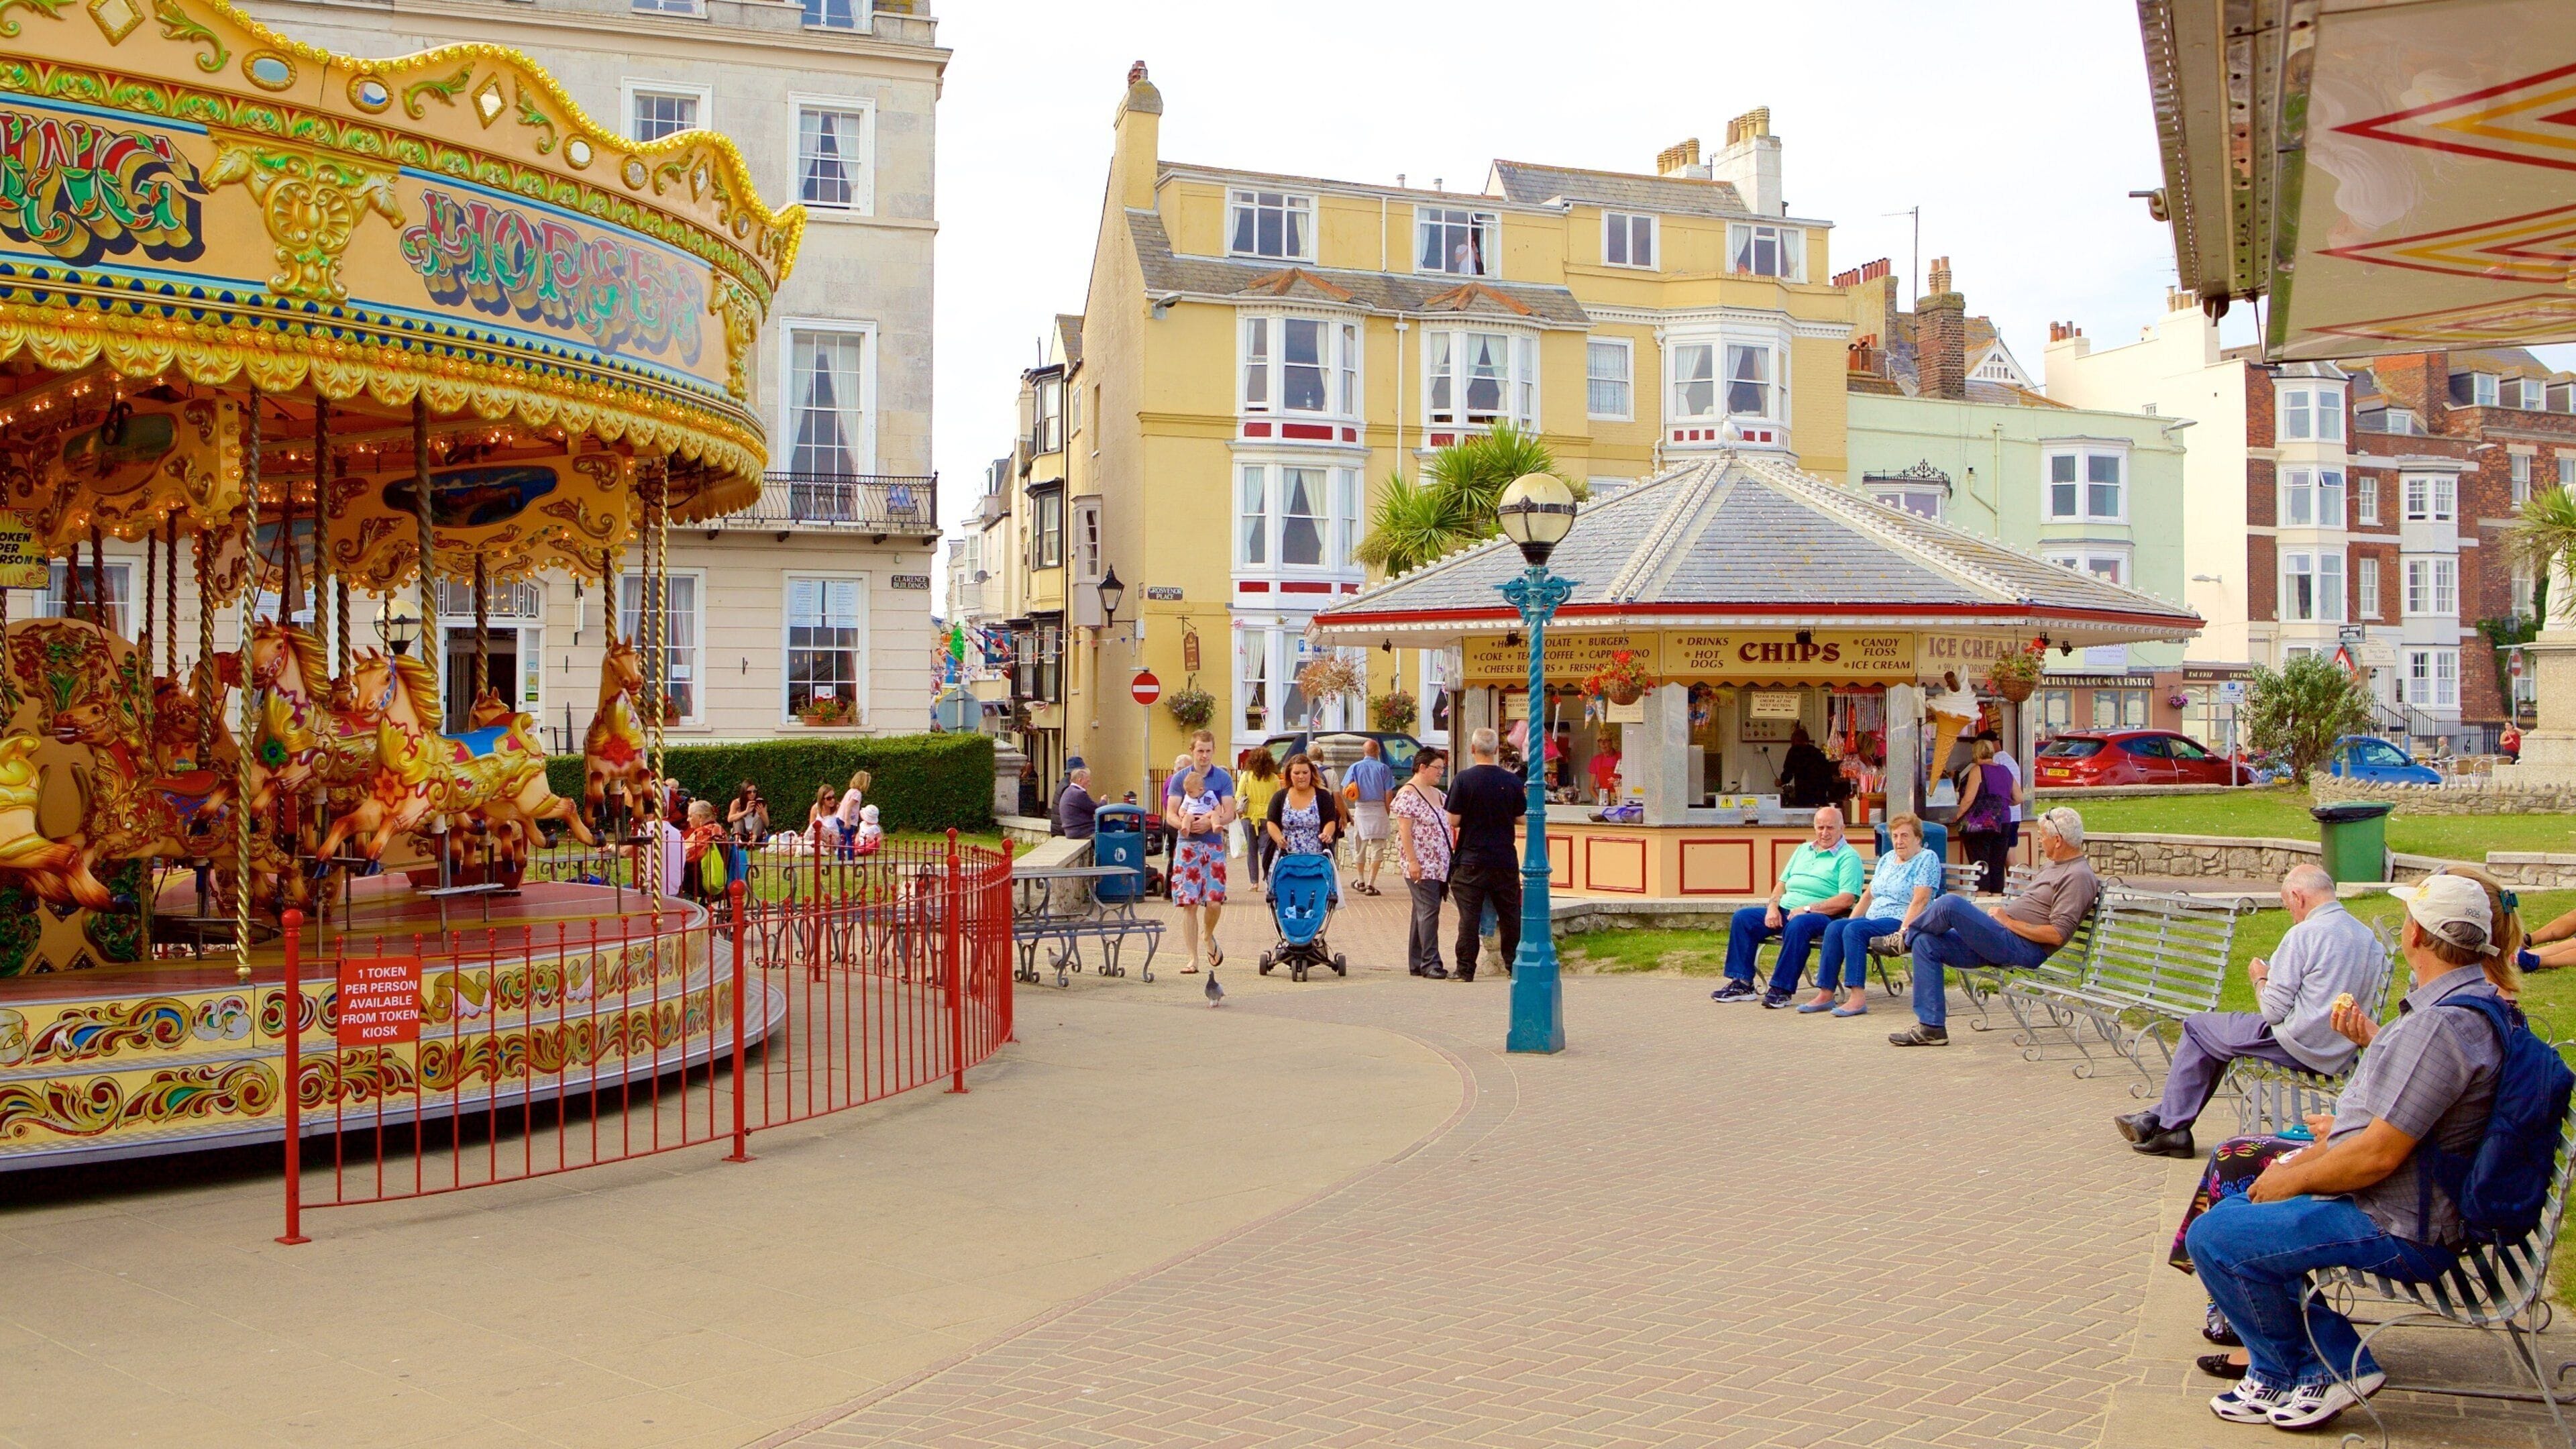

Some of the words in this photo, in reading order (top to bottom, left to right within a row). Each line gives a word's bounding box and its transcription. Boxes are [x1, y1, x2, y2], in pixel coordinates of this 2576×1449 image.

[400, 189, 701, 359] HORSES
[1519, 638, 1572, 648] CHOLATE
[1589, 637, 1629, 646] BURGERS
[1687, 637, 1729, 646] DRINKS
[1861, 638, 1900, 647] CANDY
[1929, 637, 1957, 656] ICE
[1480, 653, 1503, 661] COKE
[1544, 651, 1574, 660] COFFEE
[1695, 650, 1721, 659] HOT
[1738, 642, 1841, 663] CHIPS
[1864, 647, 1896, 656] FLOSS
[1485, 665, 1514, 674] CHEESE
[1517, 664, 1556, 673] BURS
[1570, 663, 1596, 672] FRESH
[1690, 659, 1724, 669] DOGS
[1851, 661, 1868, 669] ICE
[1872, 661, 1911, 669] CREAM
[2041, 676, 2067, 686] ACTUS
[2069, 677, 2085, 686] TEA
[2087, 678, 2115, 686] ROOMS
[2124, 678, 2153, 686] BISTRO
[358, 969, 363, 979] 1
[368, 966, 407, 978] TOKEN
[345, 984, 367, 995] PER
[370, 980, 417, 993] PERSON
[349, 995, 412, 1010] AVAILABLE
[341, 1012, 376, 1024] FROM
[380, 1009, 419, 1022] TOKEN
[362, 1026, 397, 1038] KIOSK
